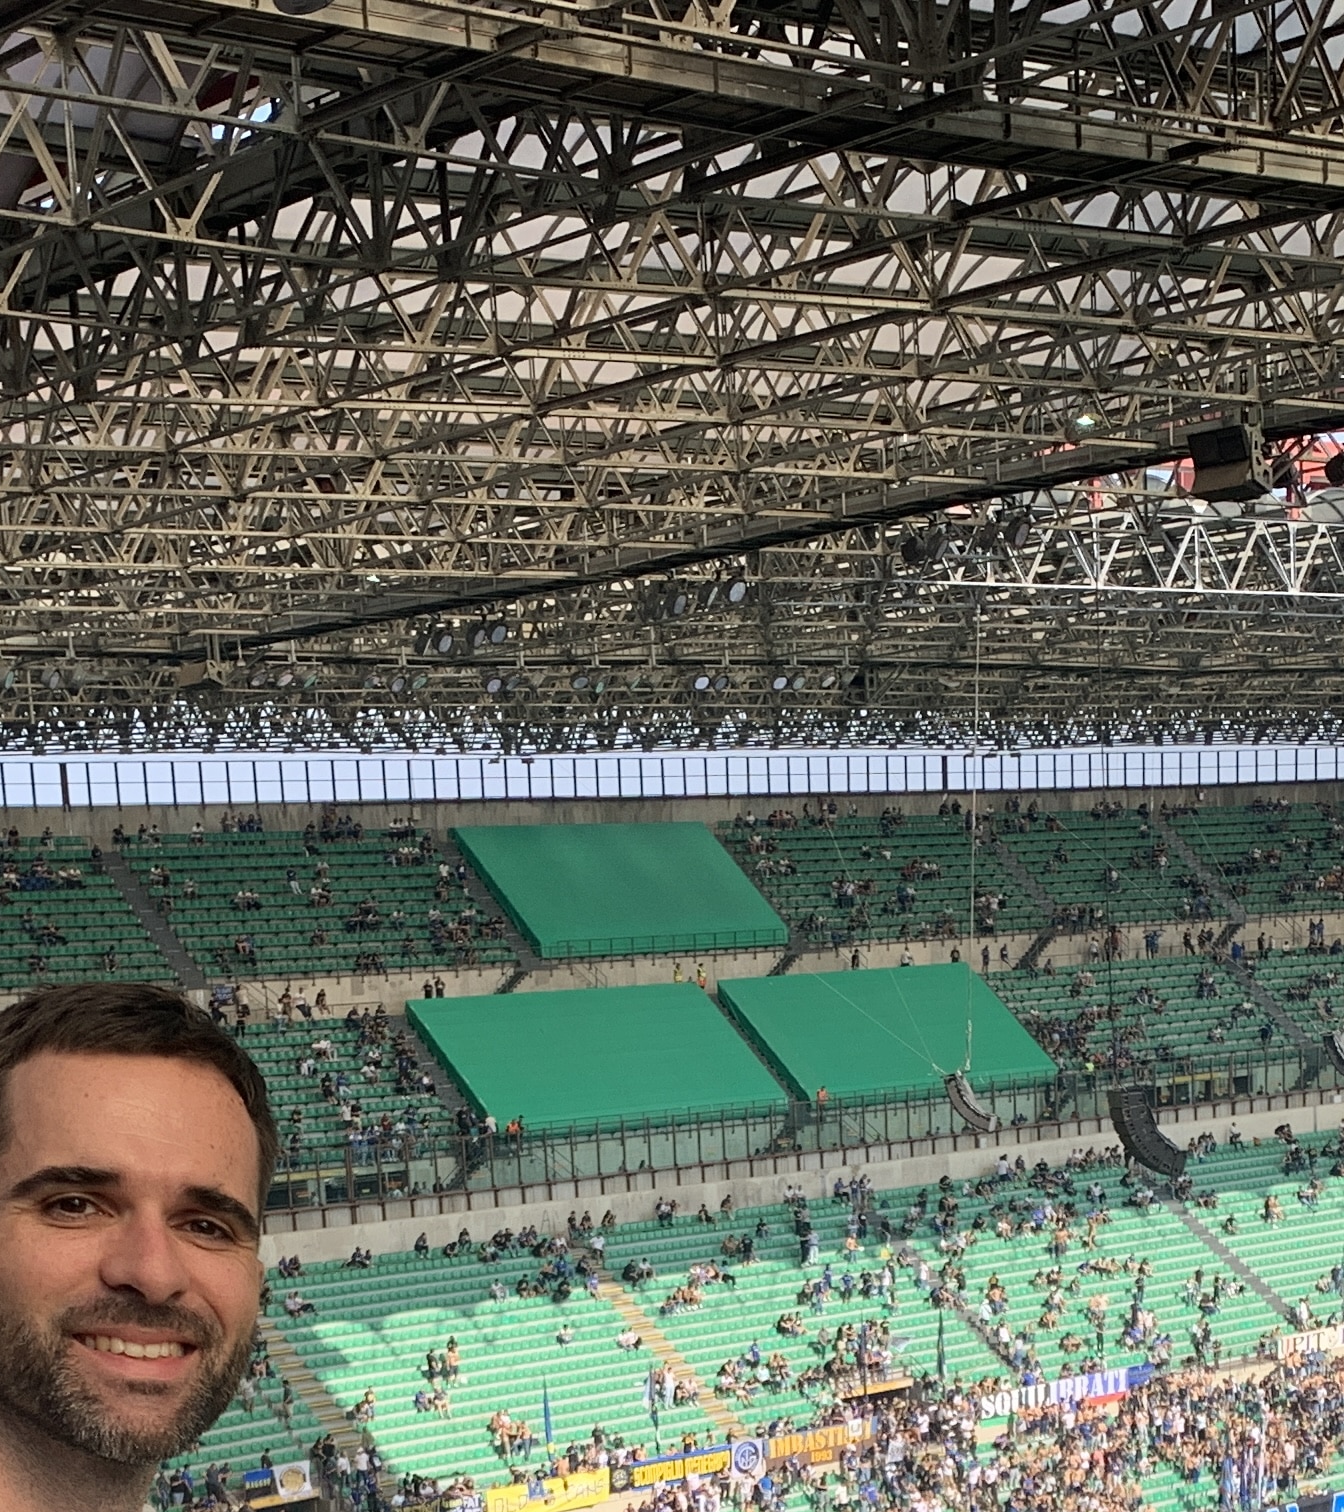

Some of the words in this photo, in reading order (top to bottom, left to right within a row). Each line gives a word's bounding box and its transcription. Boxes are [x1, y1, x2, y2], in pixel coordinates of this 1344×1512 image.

[1292, 1331, 1326, 1354] PIT
[981, 1368, 1128, 1420] SQUILIBRATI
[810, 1449, 833, 1463] 1993
